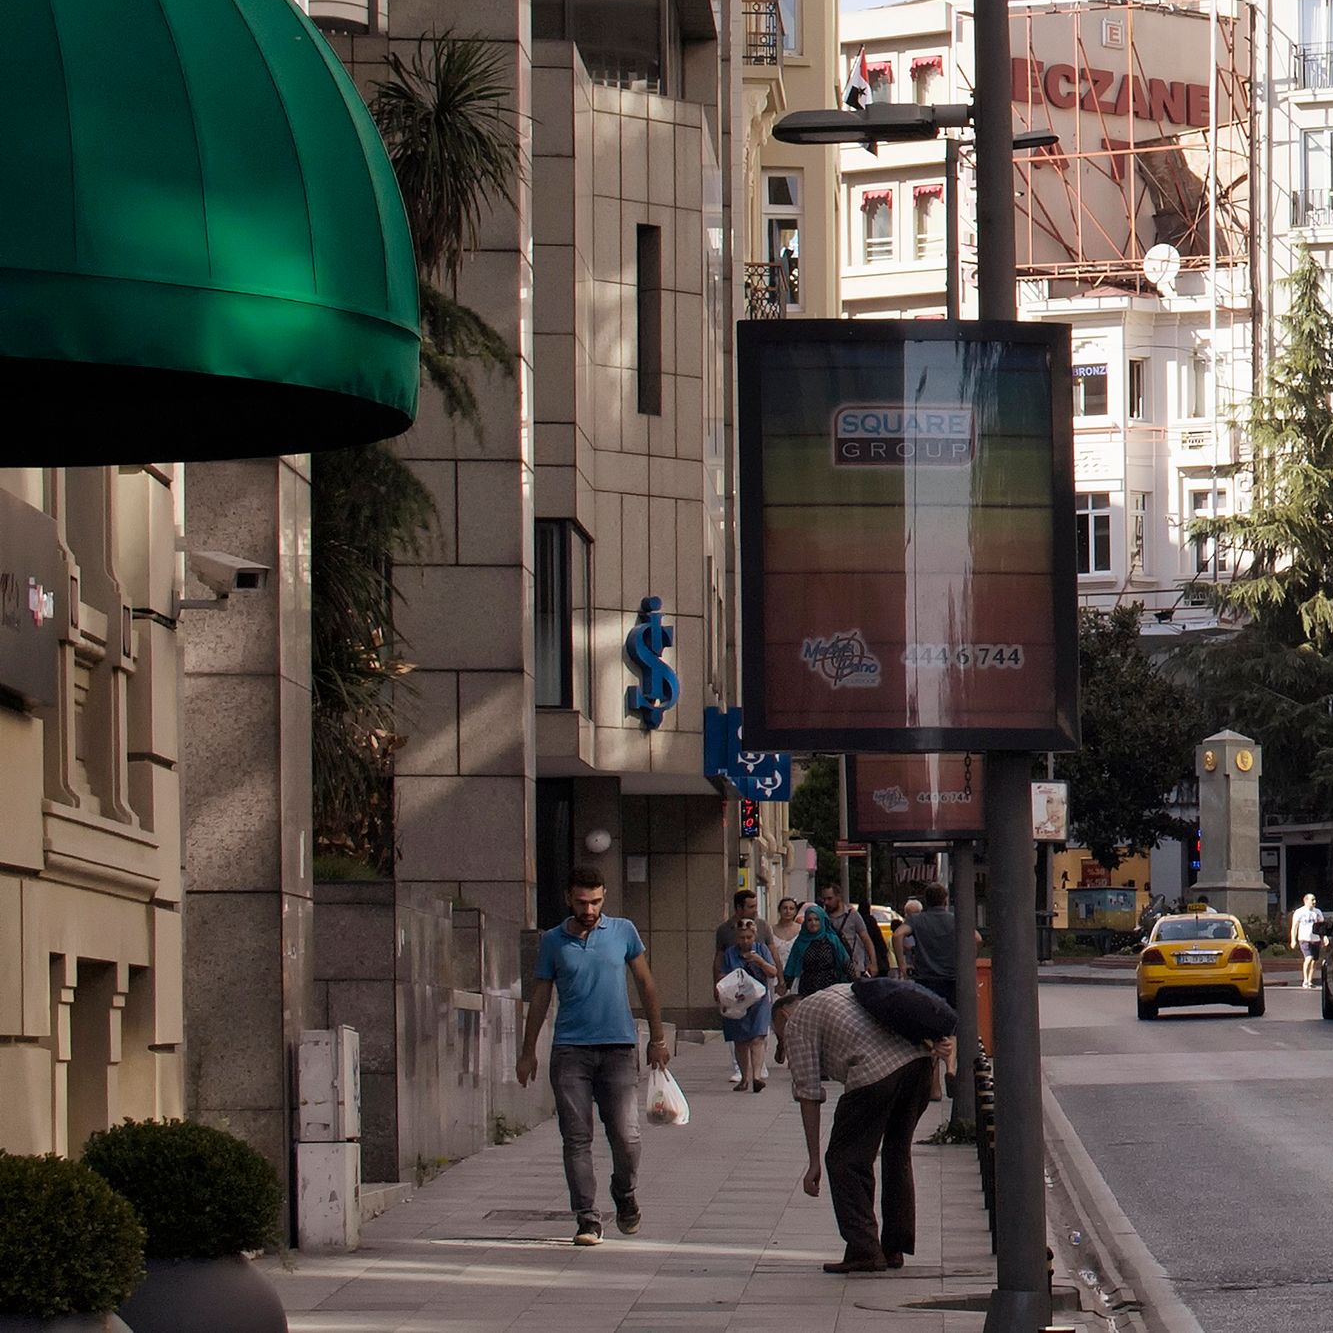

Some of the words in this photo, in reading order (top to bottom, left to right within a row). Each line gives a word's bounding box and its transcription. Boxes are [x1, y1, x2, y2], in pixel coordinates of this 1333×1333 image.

[1011, 57, 1213, 127] ECZANE
[842, 413, 967, 436] SQUARE
[842, 442, 968, 458] GROUP
[956, 648, 970, 665] 6
[978, 647, 1021, 665] 744
